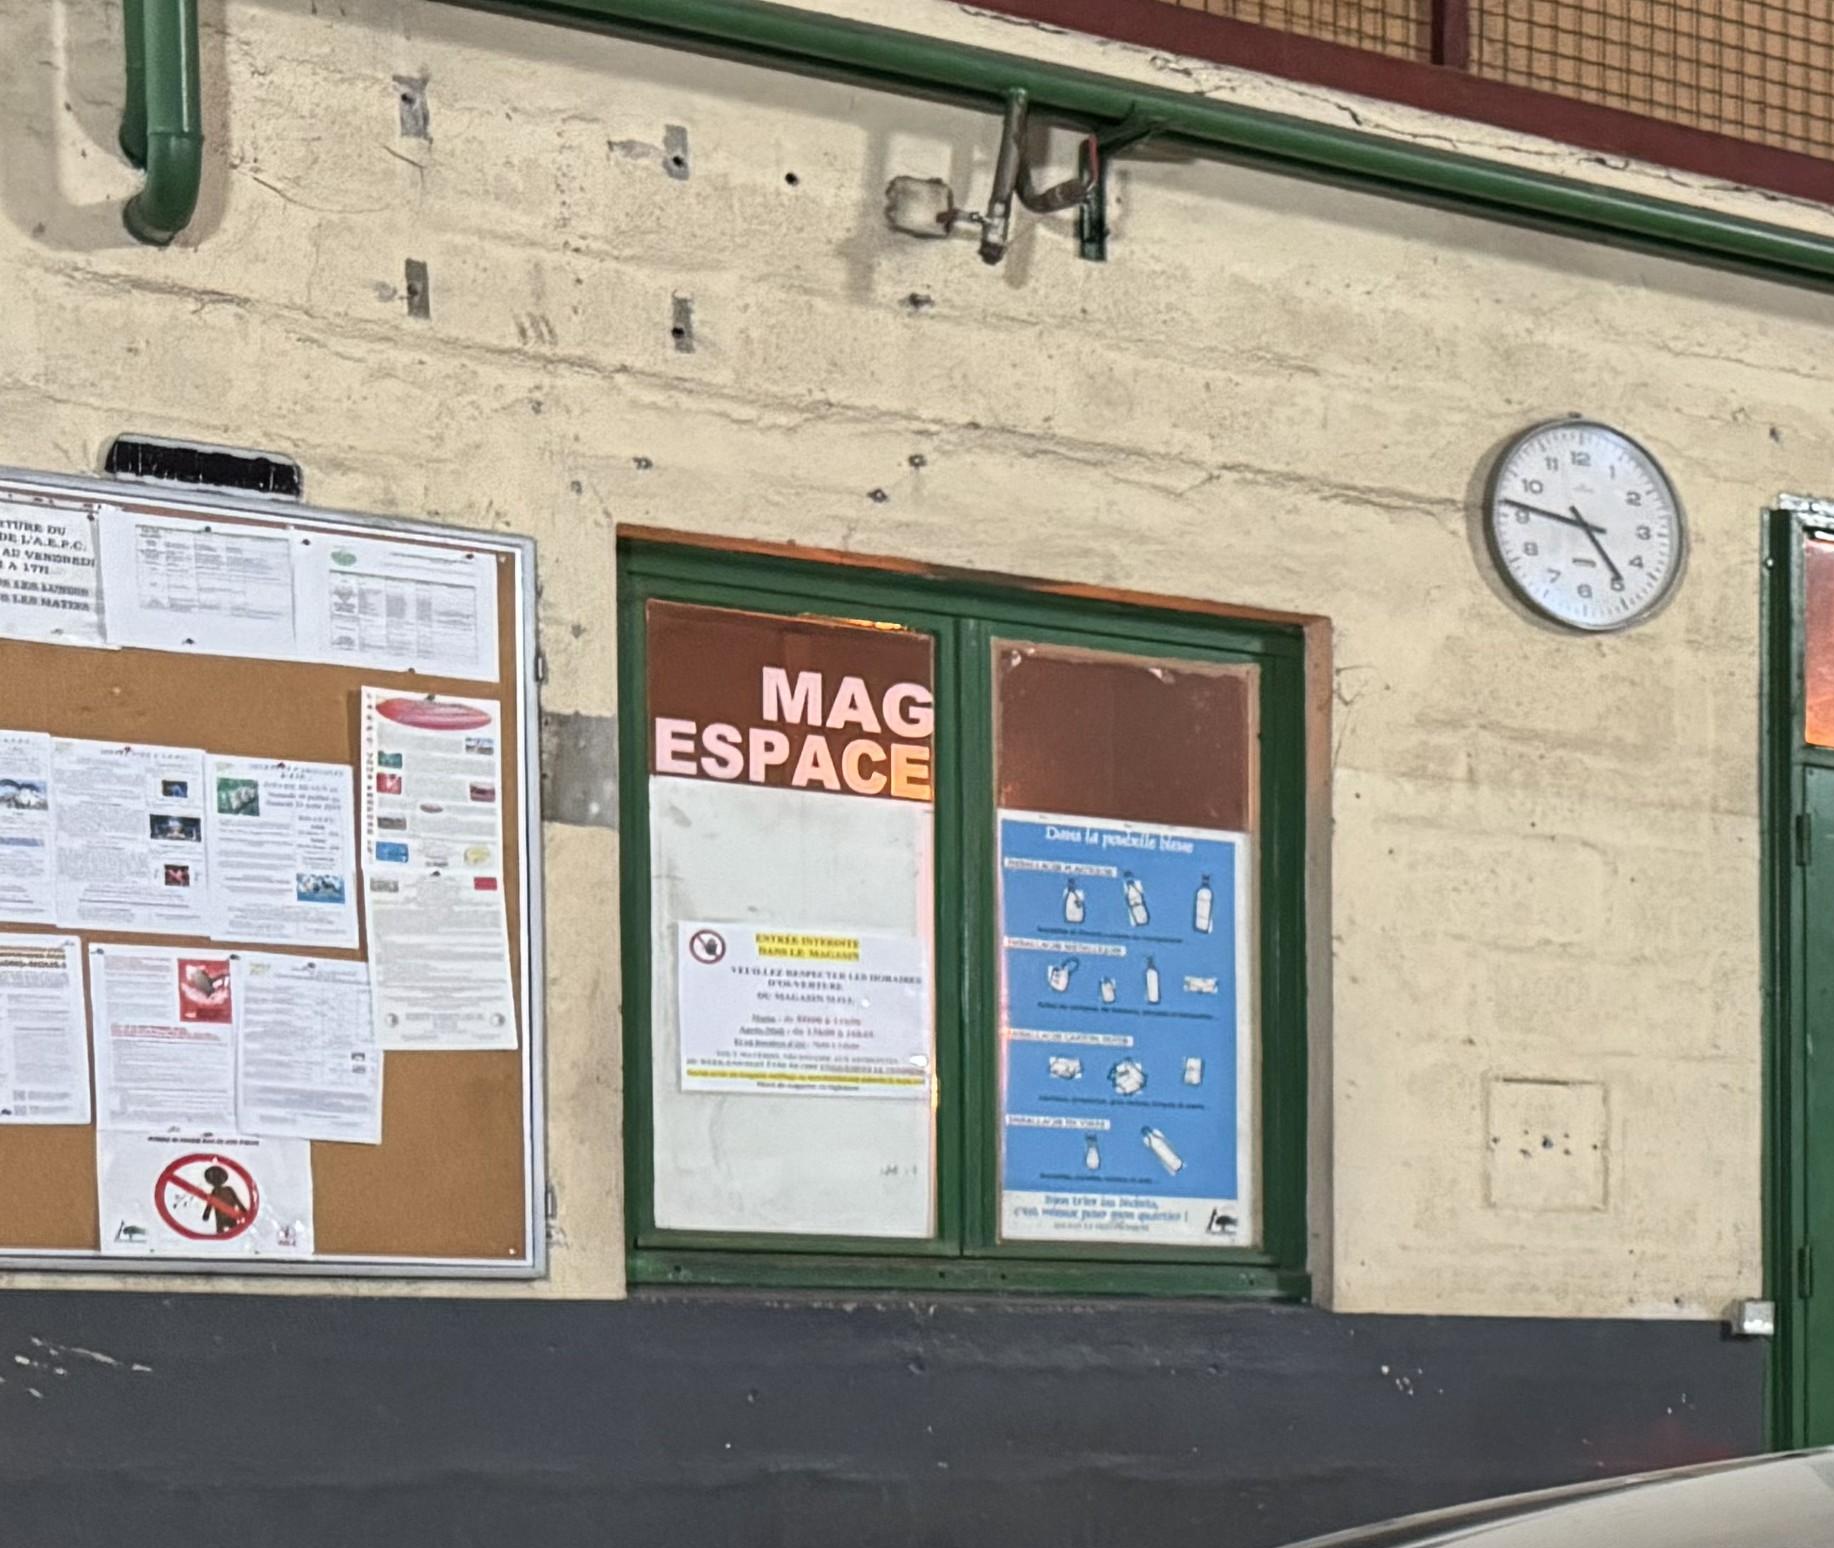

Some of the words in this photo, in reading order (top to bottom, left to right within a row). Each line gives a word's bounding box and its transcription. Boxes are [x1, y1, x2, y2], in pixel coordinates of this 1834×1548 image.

[1545, 457, 1558, 471] 11
[1571, 451, 1591, 467] 12
[1609, 465, 1616, 479] 1
[1521, 478, 1544, 495] 10
[1626, 491, 1642, 507] 2
[1515, 508, 1530, 524] 9
[47, 525, 66, 536] DU
[1636, 525, 1651, 540] 3
[1524, 542, 1538, 556] 8
[1628, 555, 1644, 569] 4
[1547, 568, 1561, 583] 7
[1577, 584, 1592, 598] 6
[1610, 577, 1625, 592] 5
[763, 666, 934, 738] MAG
[655, 717, 932, 800] ESPACE
[1045, 826, 1081, 842] Dans
